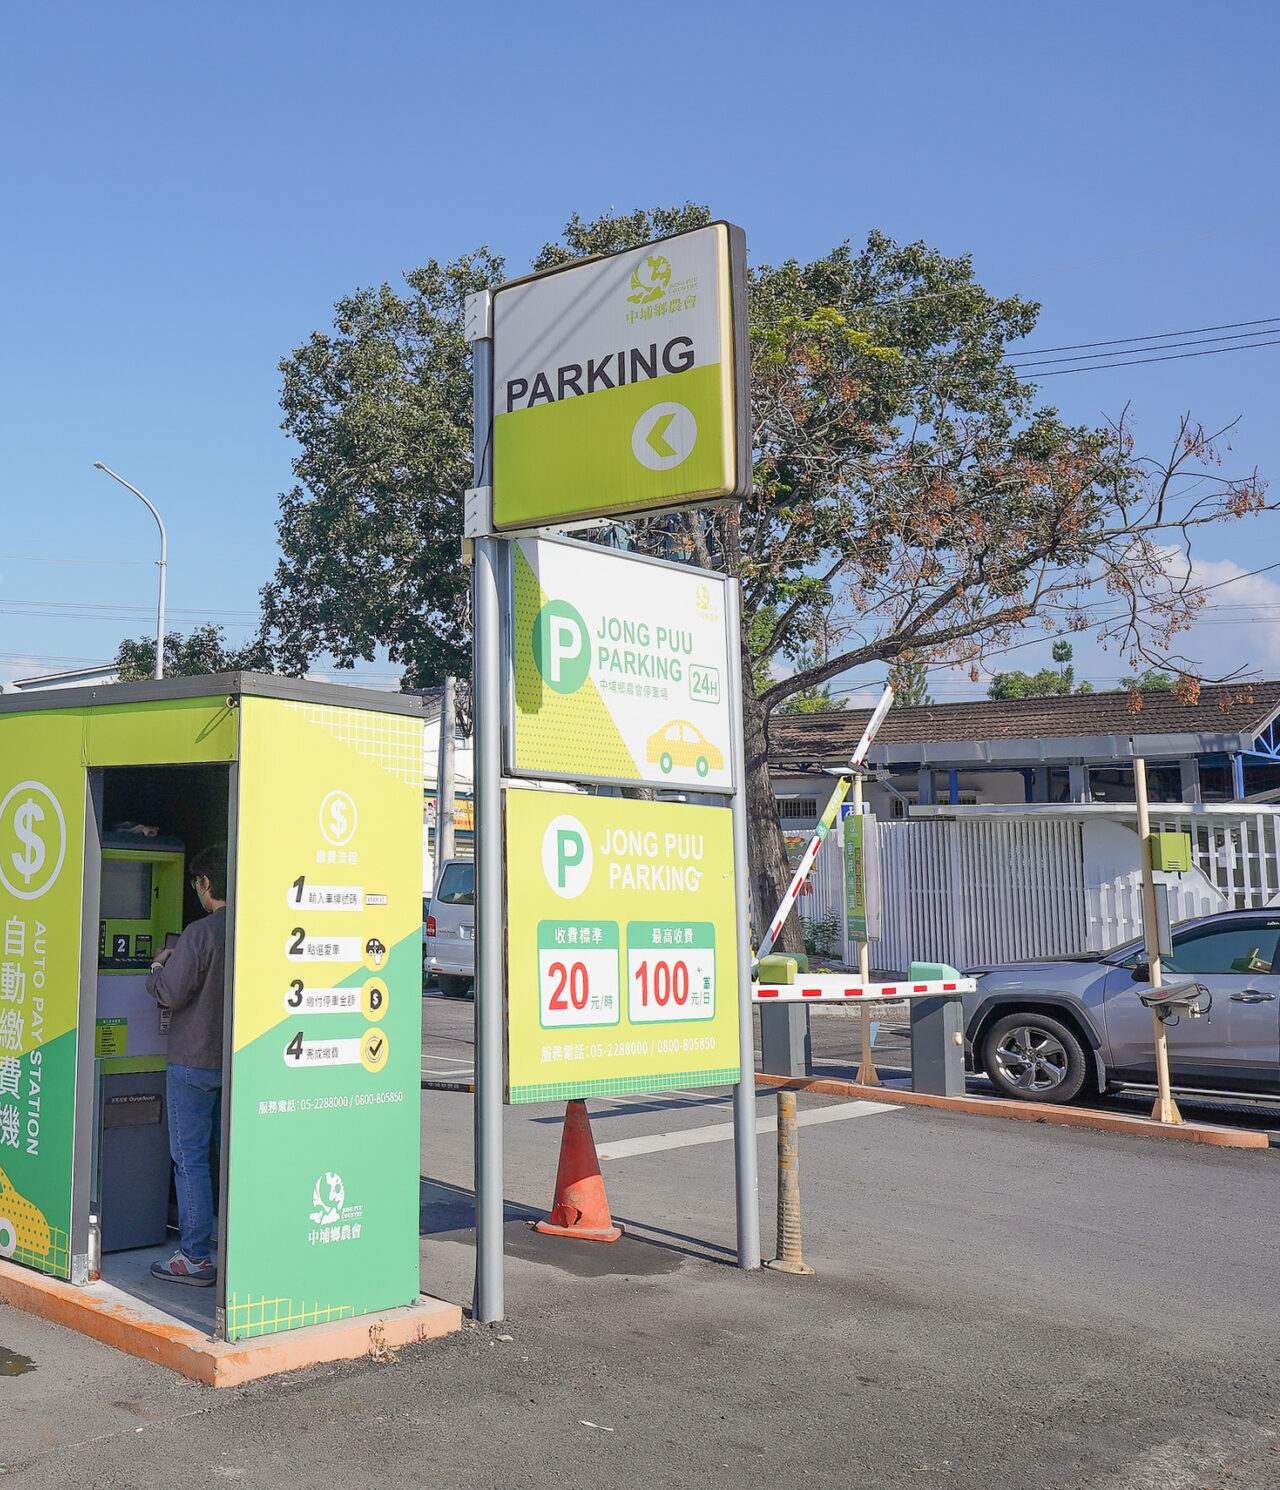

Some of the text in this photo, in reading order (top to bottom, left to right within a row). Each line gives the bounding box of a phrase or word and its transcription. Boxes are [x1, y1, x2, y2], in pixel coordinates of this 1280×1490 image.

[626, 295, 696, 325] 中埔鄉農會
[507, 336, 695, 413] PARKING
[550, 615, 582, 683] P
[597, 616, 692, 654] JONG PUU
[598, 646, 682, 682] PARKING
[600, 680, 668, 701] 中埔鄉農會停車場
[692, 671, 717, 697] 24H
[557, 830, 584, 888] P
[600, 829, 704, 860] JONG PUU
[293, 875, 357, 905] 1 輸入車牌號碼
[609, 863, 700, 892] PARKING
[117, 938, 126, 953] 2
[289, 927, 306, 955] 2
[555, 927, 603, 944] 收費標準
[652, 928, 694, 944] 最高收費
[287, 979, 304, 1007] 3
[548, 961, 589, 1010] 20
[635, 960, 689, 1007] 100
[26, 920, 47, 1156] AUTO PAY STATION
[286, 1032, 304, 1060] 4
[657, 1037, 715, 1053] 0800-805850
[355, 1091, 403, 1106] 0800-805850
[308, 1223, 361, 1246] 中埔鄉農會
